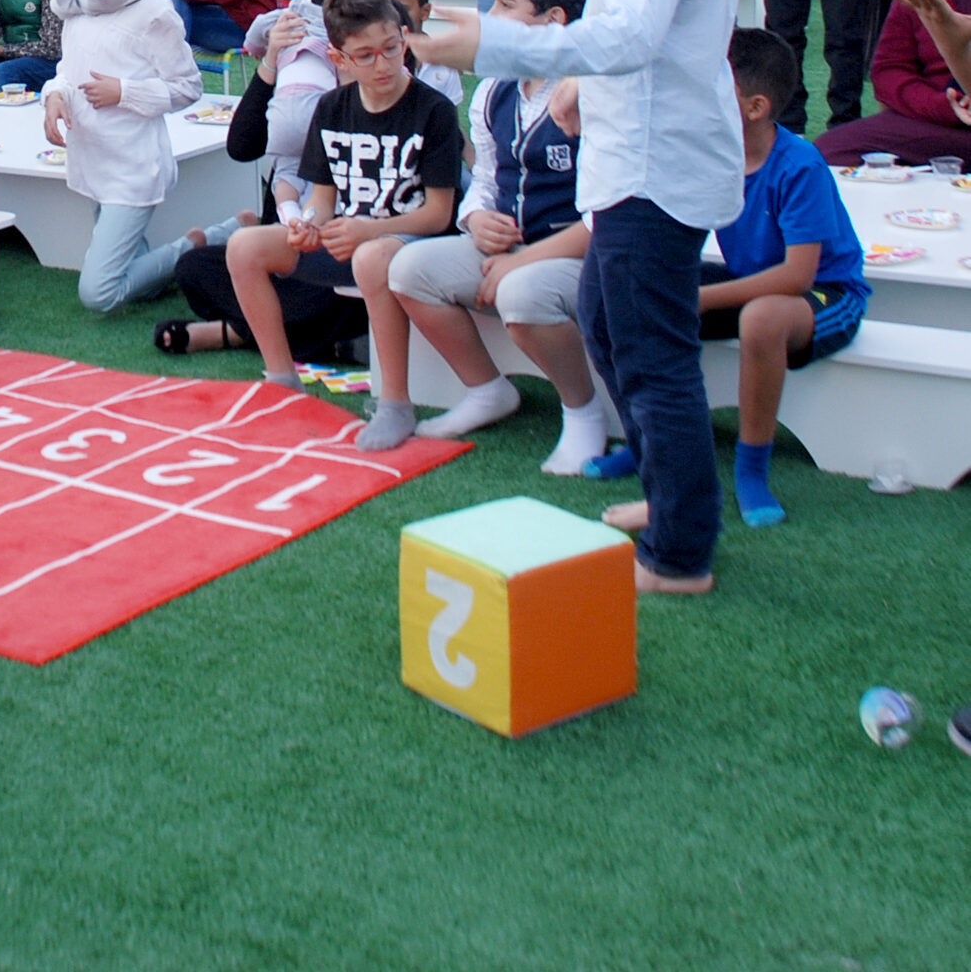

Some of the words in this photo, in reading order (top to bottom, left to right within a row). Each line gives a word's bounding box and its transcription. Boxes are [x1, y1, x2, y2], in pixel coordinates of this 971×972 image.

[320, 129, 424, 179] EPIC
[41, 428, 127, 461] 3
[142, 449, 240, 486] 2
[254, 474, 327, 511] 1
[425, 566, 477, 691] 2
